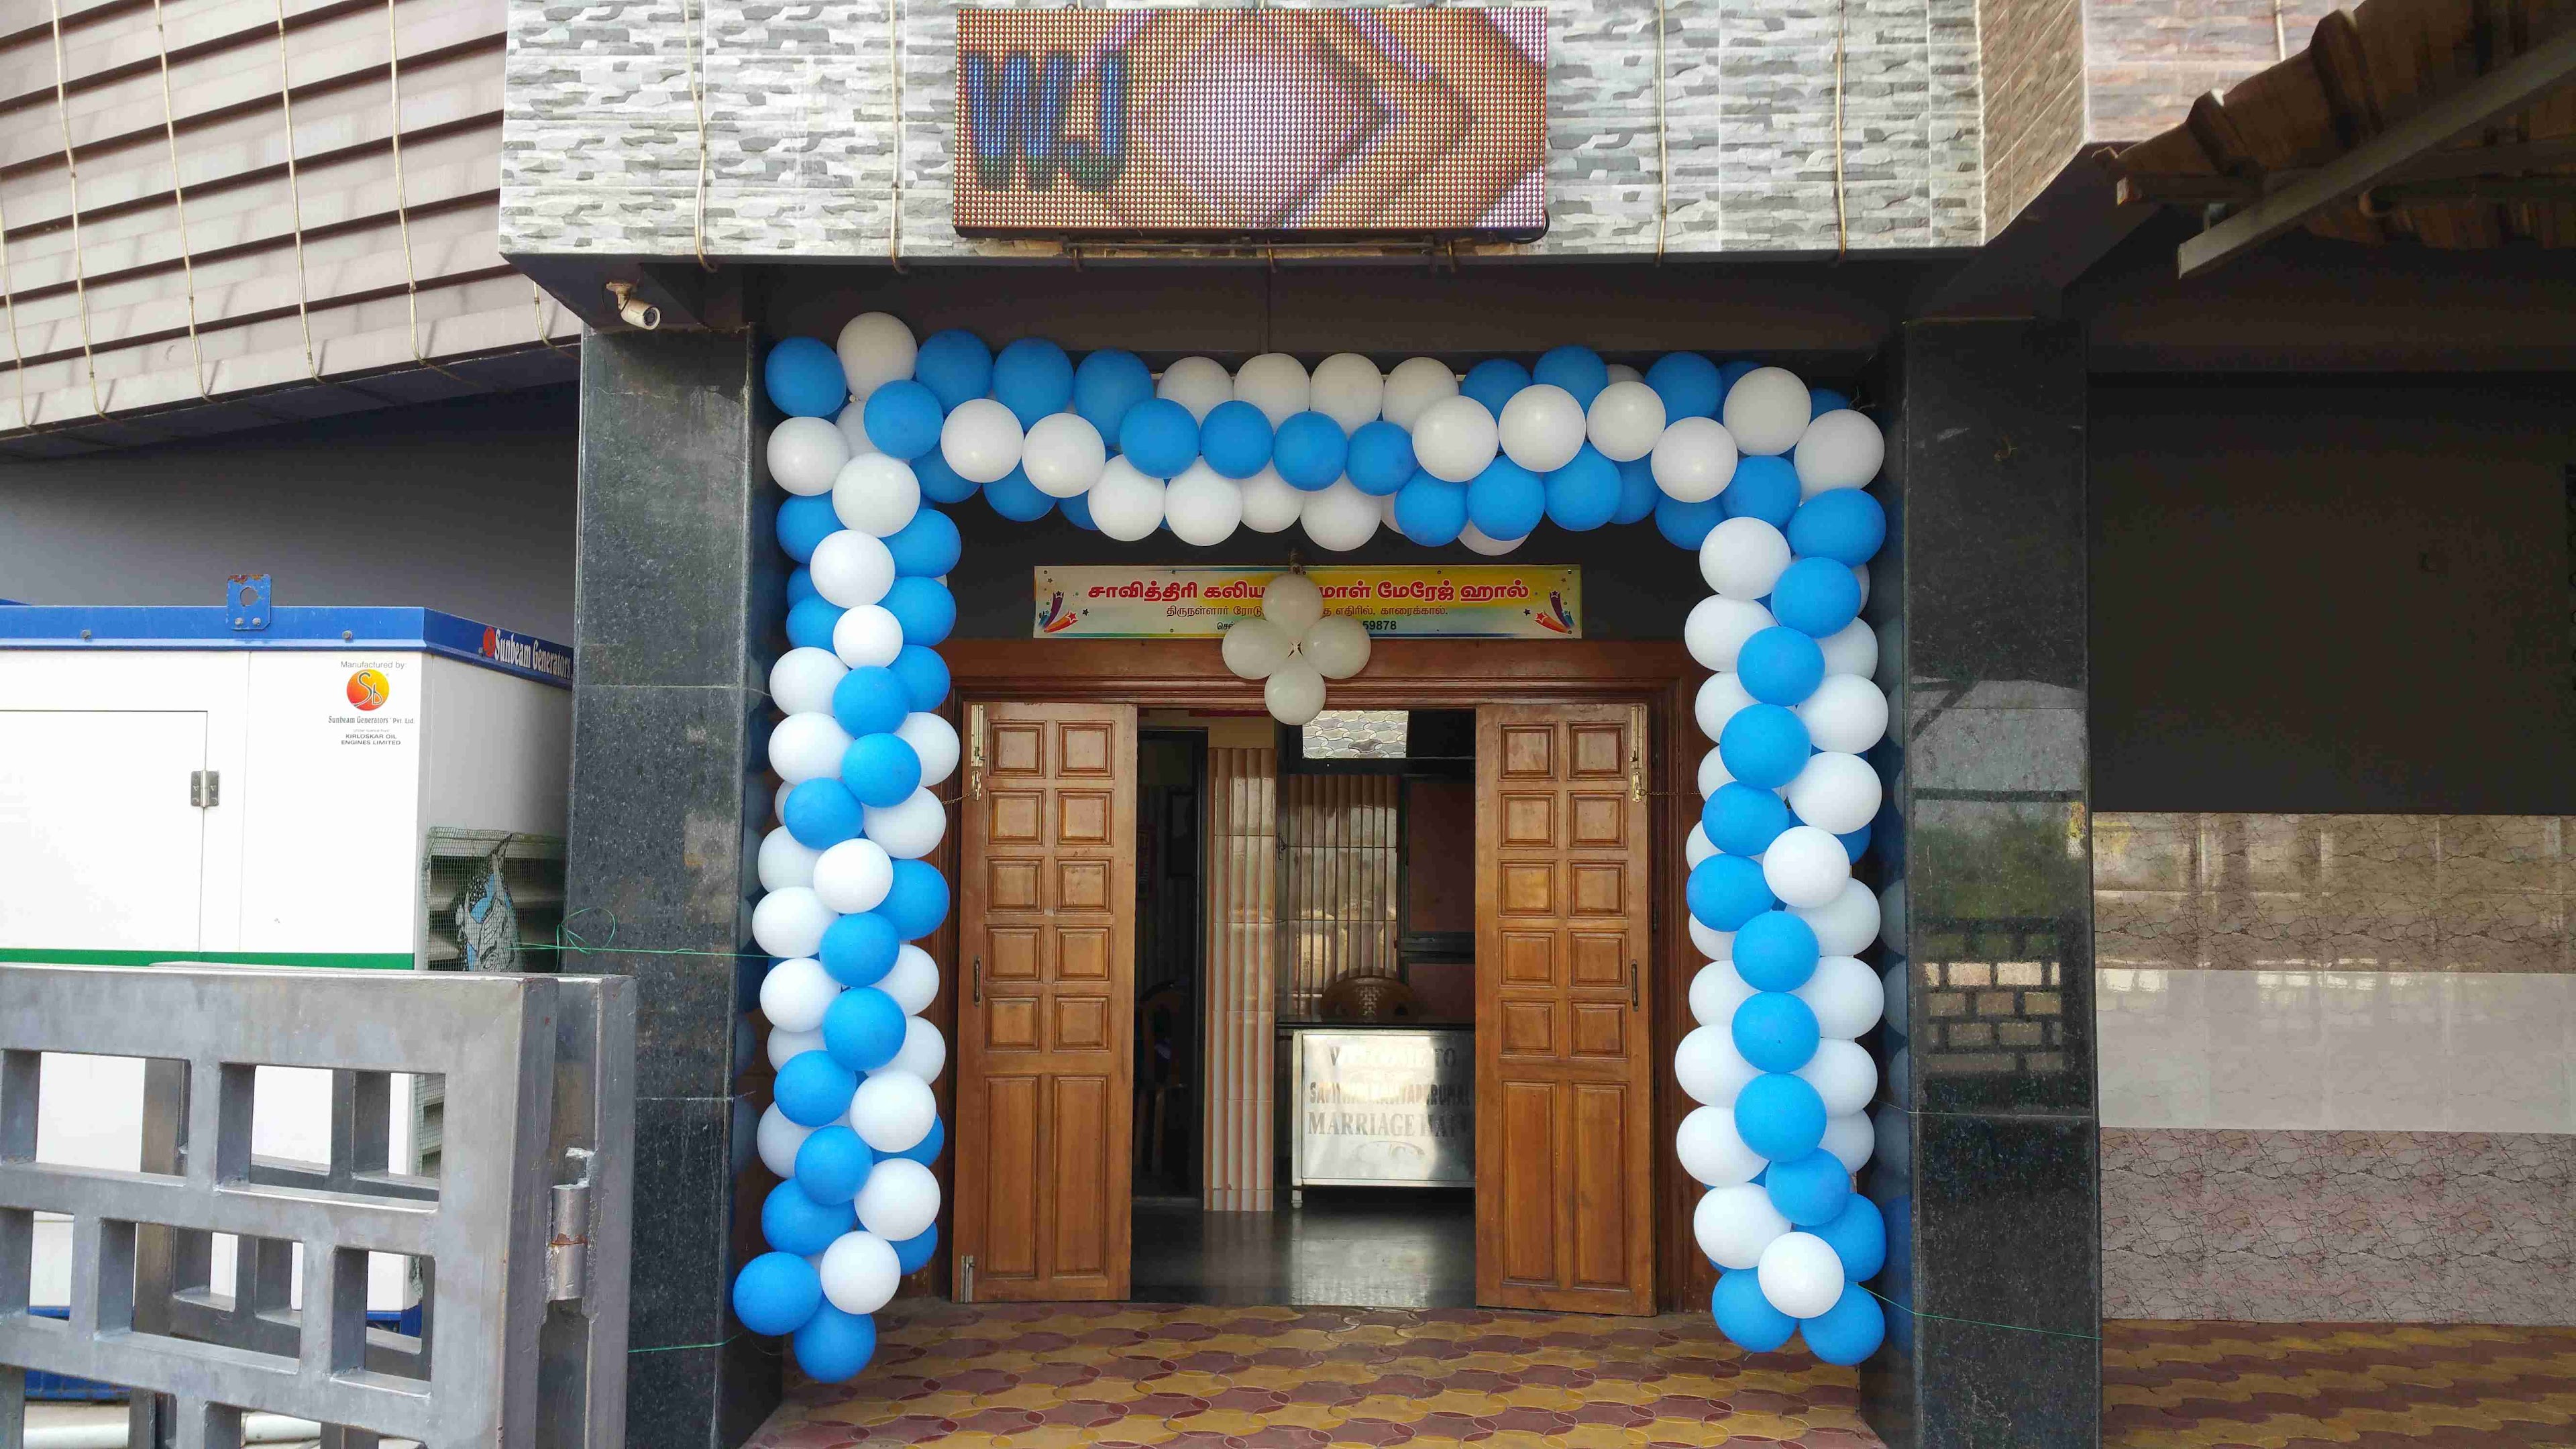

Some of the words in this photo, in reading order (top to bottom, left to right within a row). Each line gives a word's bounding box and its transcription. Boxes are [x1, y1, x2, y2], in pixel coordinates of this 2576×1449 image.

[1088, 580, 1197, 601] சாவித்திரி
[1377, 580, 1454, 601] மேரேஜ்
[1460, 580, 1529, 601] ஹால்
[1167, 605, 1229, 617] திருநள்ளார்
[494, 628, 531, 669] Sunbeam
[532, 639, 571, 678] Generators
[357, 716, 388, 724] Generators
[1308, 1112, 1415, 1136] MARRIAGE
